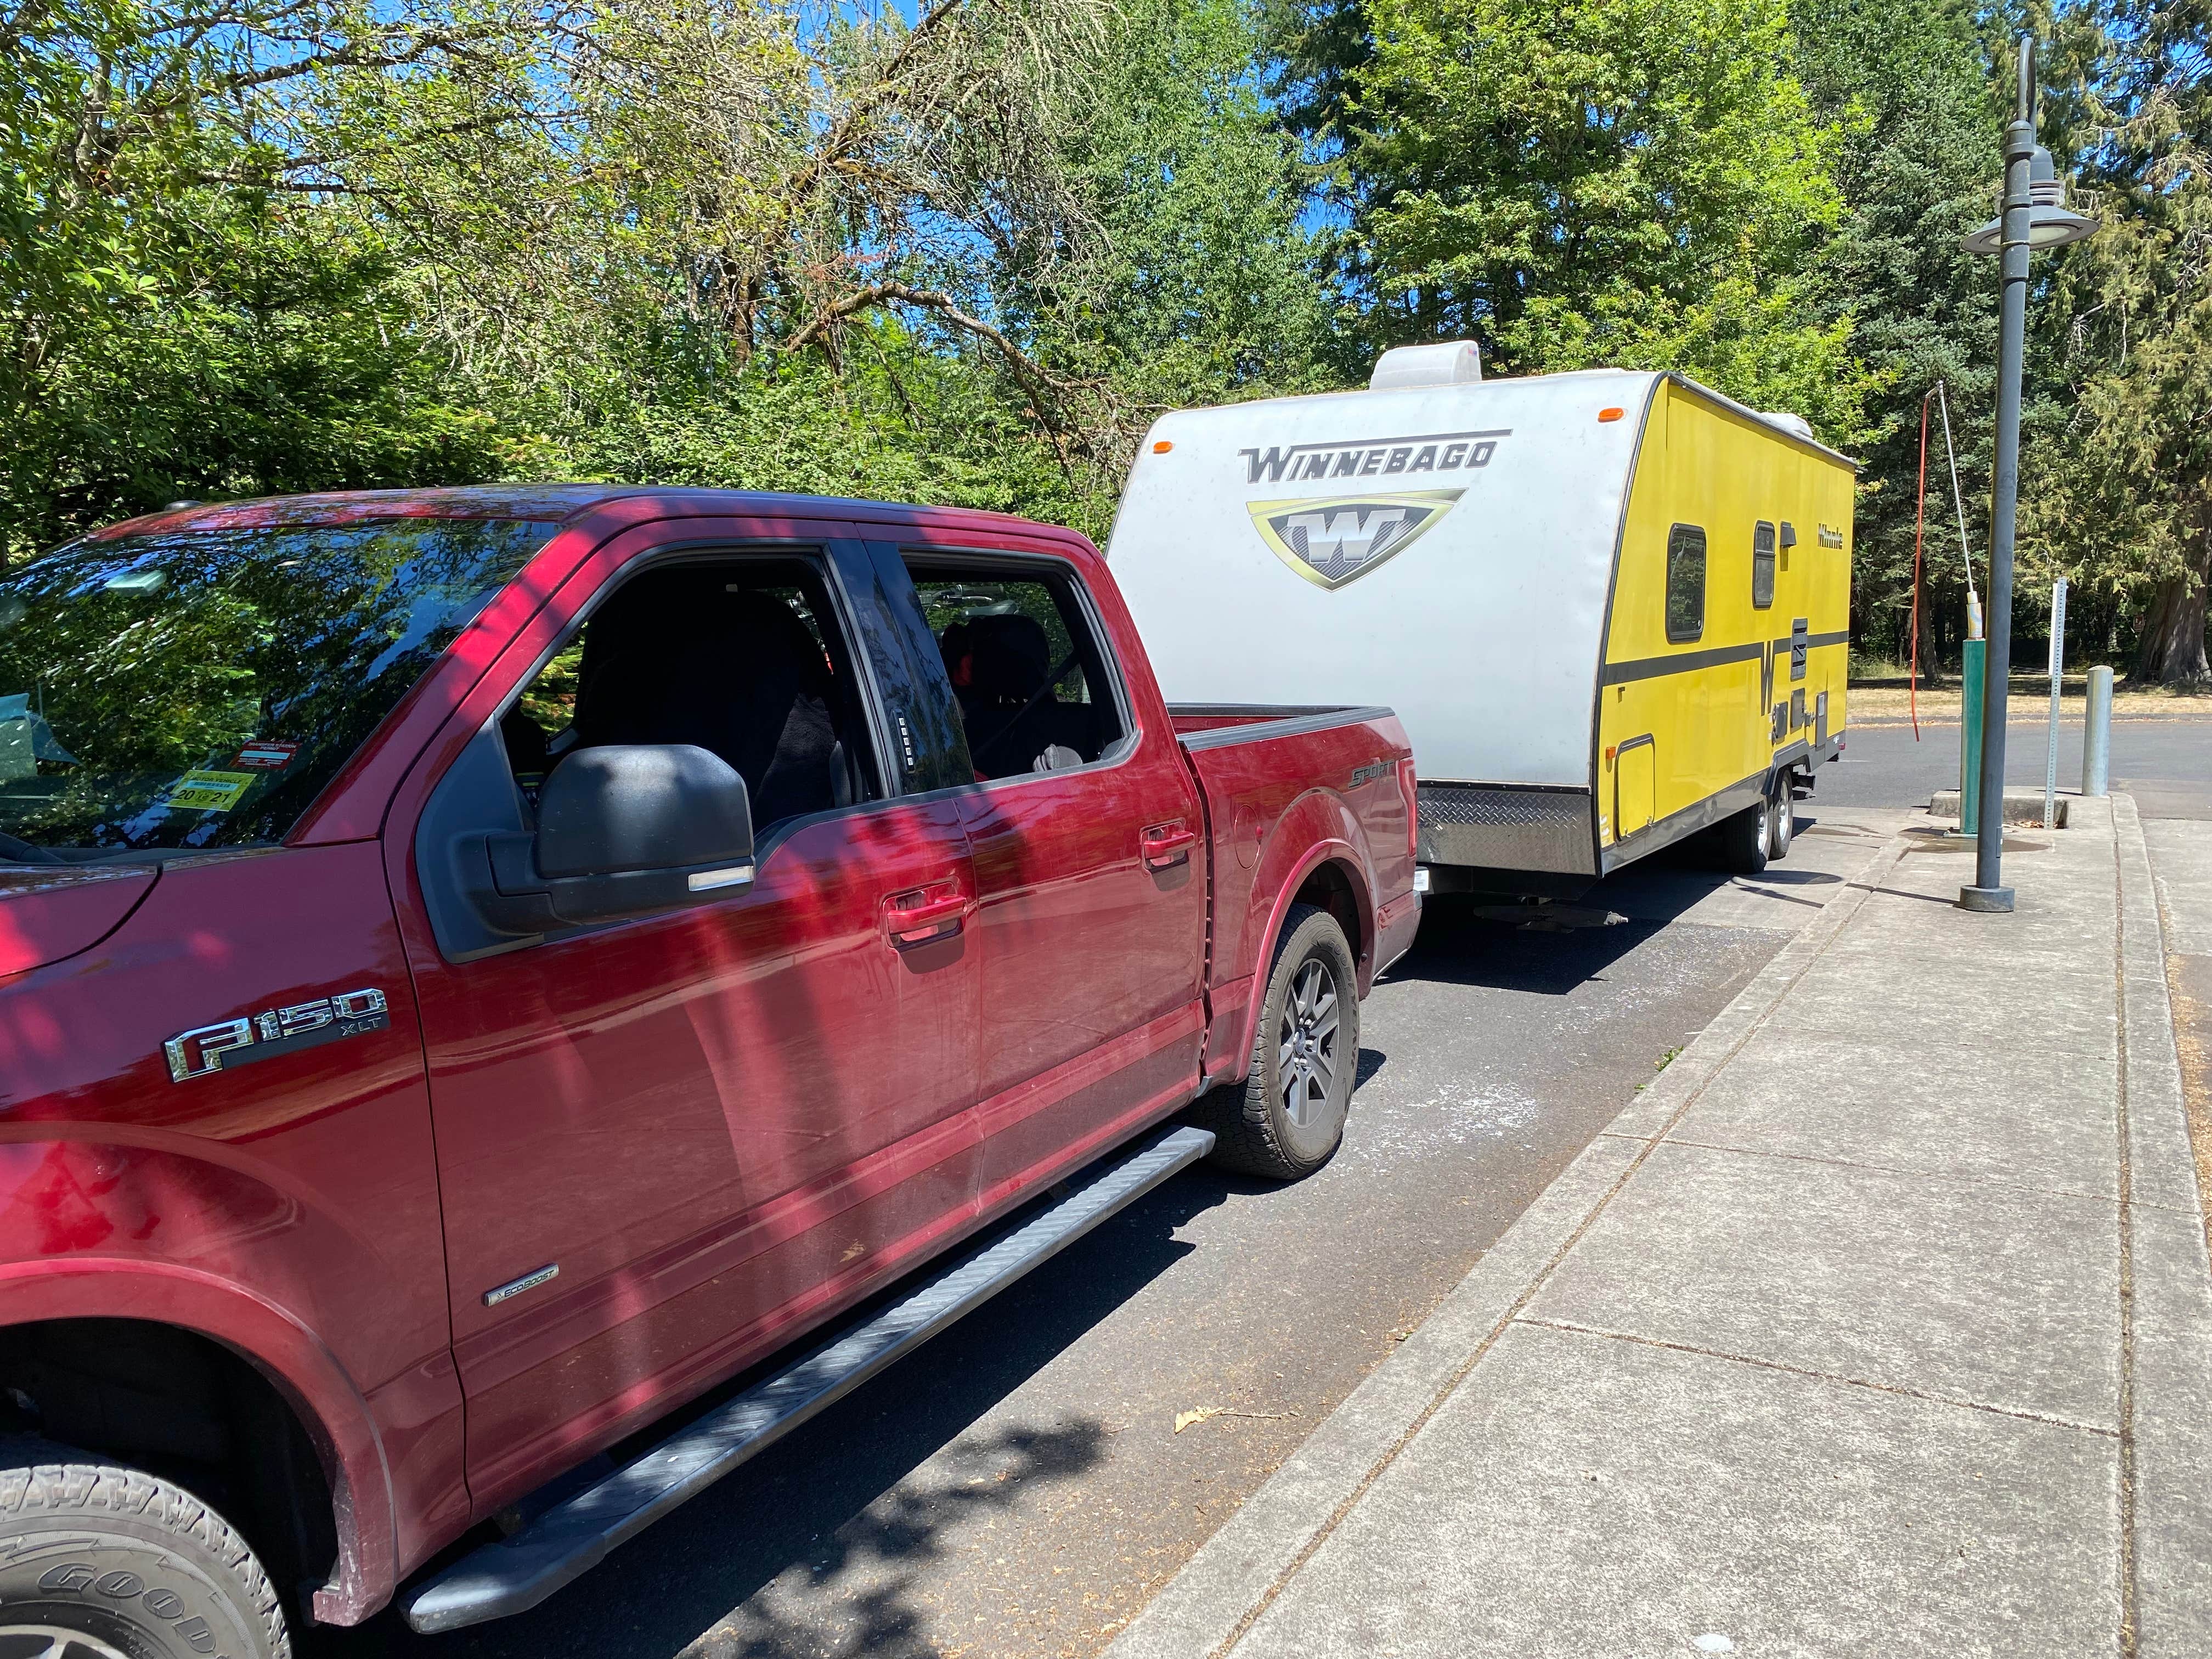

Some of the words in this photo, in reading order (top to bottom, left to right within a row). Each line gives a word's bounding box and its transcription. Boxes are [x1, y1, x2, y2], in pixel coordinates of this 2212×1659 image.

[1237, 428, 1513, 484] WINNEBAGO
[1287, 509, 1406, 563] W
[1348, 759, 1395, 789] SPORT
[175, 789, 195, 800] 20
[210, 792, 231, 803] 21
[340, 1017, 381, 1036] XLT
[504, 1269, 554, 1297] ECOBOOST
[37, 1562, 230, 1659] GOOD
